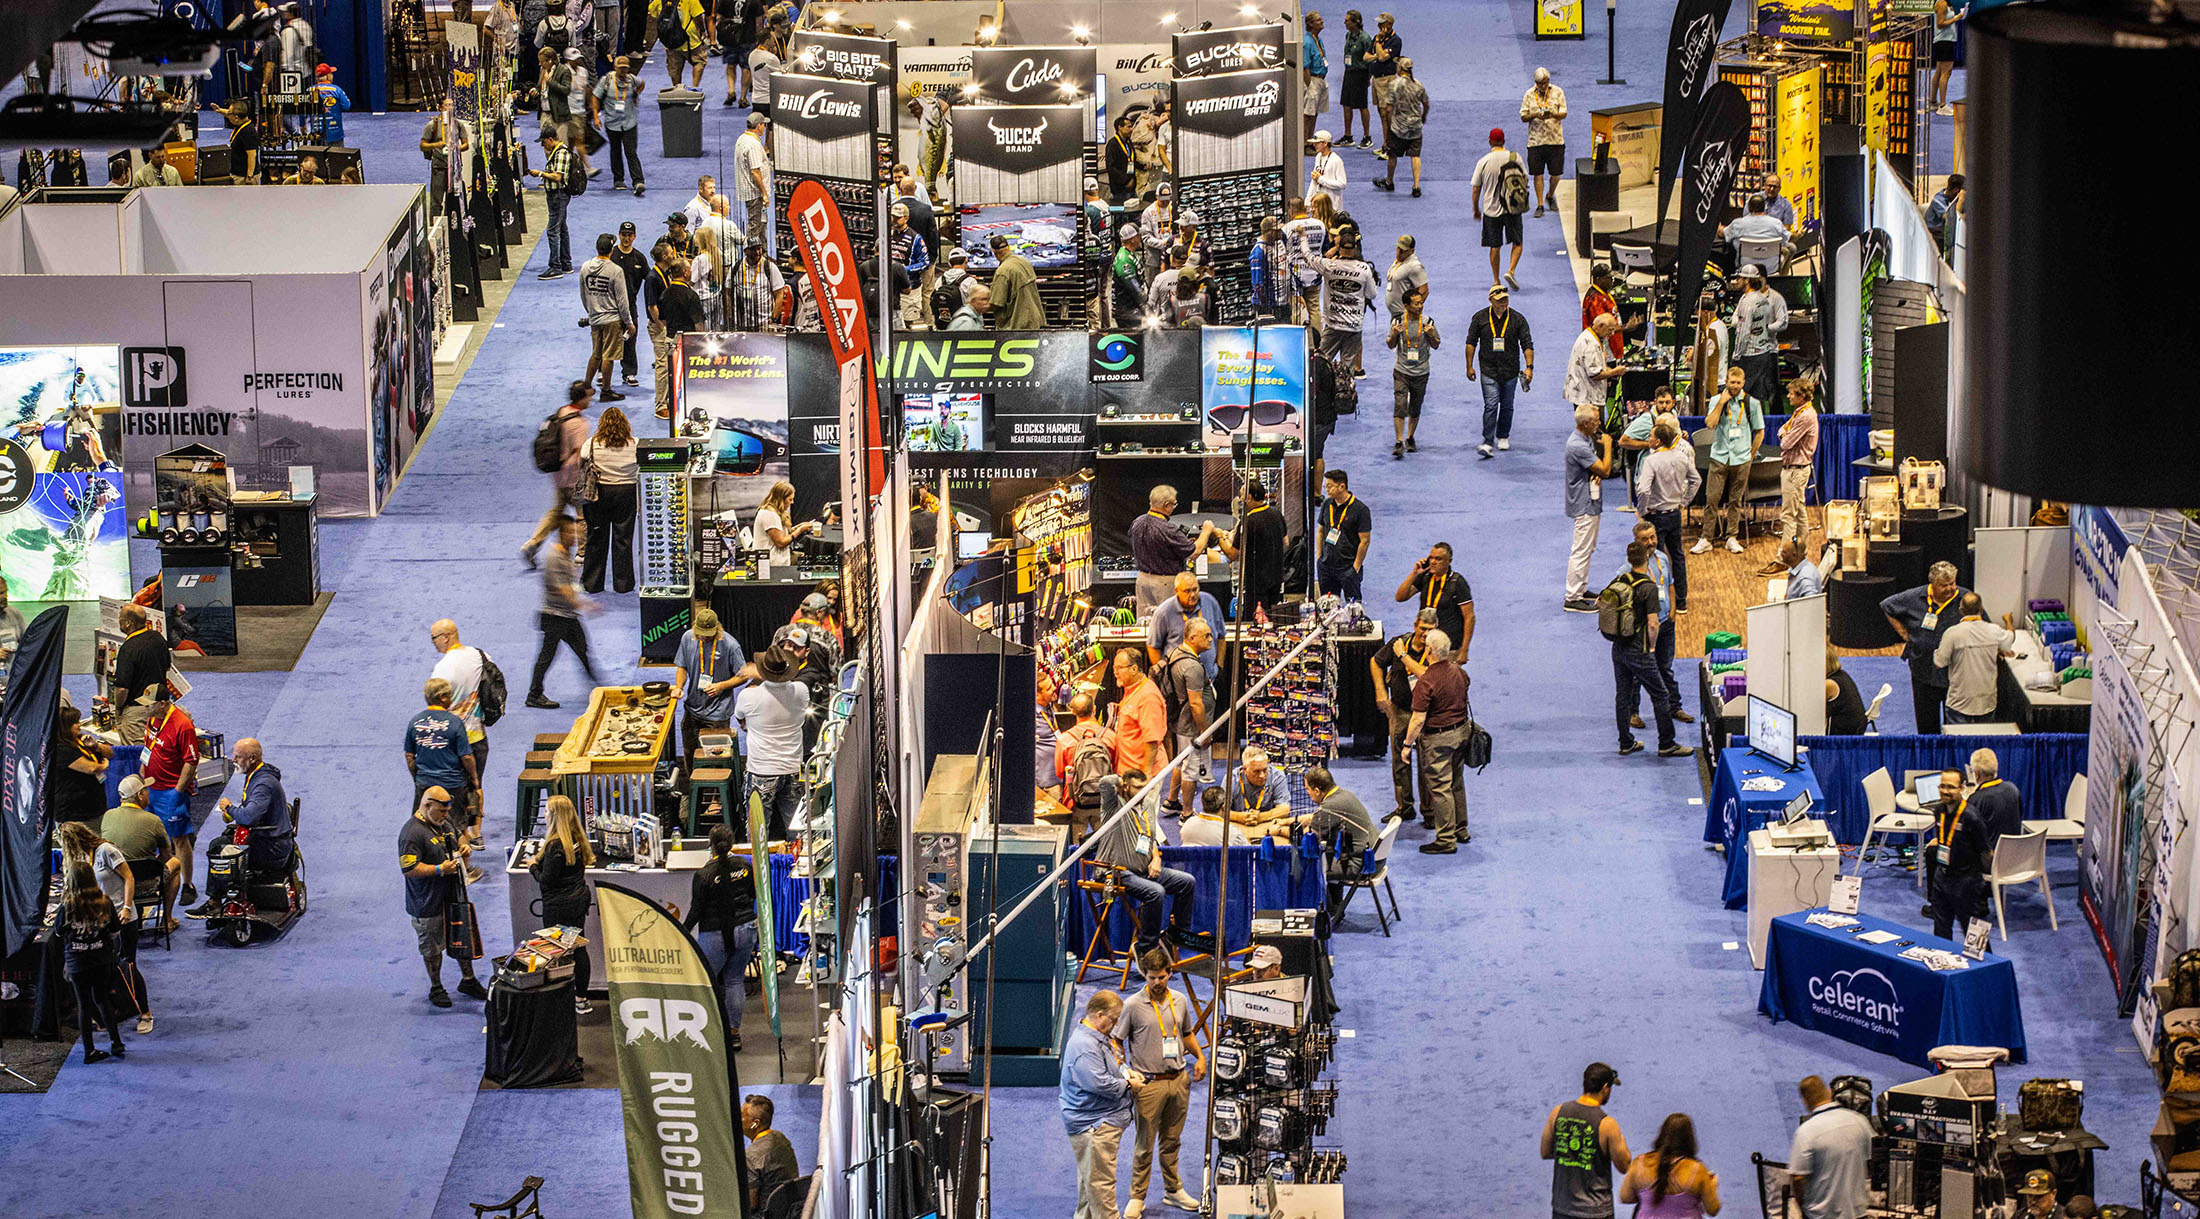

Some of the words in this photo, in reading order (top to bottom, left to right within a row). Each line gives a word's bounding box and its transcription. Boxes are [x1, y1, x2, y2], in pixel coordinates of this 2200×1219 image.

[1780, 25, 1813, 35] ROOSTER
[826, 49, 849, 63] BIG
[851, 52, 881, 66] BITE
[1680, 31, 1700, 70] LINE
[904, 63, 971, 73] YAMAMOTO
[1116, 58, 1138, 70] Bill
[1220, 58, 1244, 68] LURES
[453, 69, 475, 88] DRIP
[1005, 58, 1064, 93] Cuda
[1121, 81, 1171, 94] BUCKEY
[777, 93, 805, 111] Bill
[819, 97, 861, 118] Lewis
[1185, 92, 1274, 116] YAMAMOTO
[1244, 105, 1271, 117] BAITS
[996, 127, 1042, 145] BUCCA
[1005, 145, 1033, 153] BRAND
[1695, 154, 1716, 193] LINE
[810, 244, 825, 280] Unfair
[688, 356, 711, 366] The
[713, 356, 728, 366] #1
[730, 355, 776, 366] World's
[1217, 351, 1240, 360] The
[1245, 350, 1273, 360] Bst
[688, 369, 716, 379] Best
[718, 369, 752, 379] Sport
[754, 369, 785, 379] Lens.
[243, 372, 343, 394] PERFECTION
[960, 381, 1041, 389] PERFECTED
[1014, 424, 1045, 434] BLOCKS
[1046, 424, 1082, 434] HARMFUL
[1011, 435, 1025, 444] NEAR
[1026, 435, 1052, 444] INFRARED
[1058, 435, 1085, 444] BLUELIGHT
[940, 468, 967, 478] ENS
[973, 468, 1038, 478] TECHOLOGY
[950, 481, 974, 489] ARITY
[642, 607, 690, 647] NINES
[6, 722, 17, 755] JET
[3, 755, 15, 814] DIXIE
[608, 947, 682, 965] ULTRALIGHT
[624, 966, 660, 975] PERFORMANCE
[661, 967, 684, 975] COOLERS
[1808, 976, 1900, 1026] Celerant
[1811, 1002, 1832, 1016] Retail
[1832, 1009, 1870, 1029] Commerce
[649, 1071, 705, 1215] RUGGED
